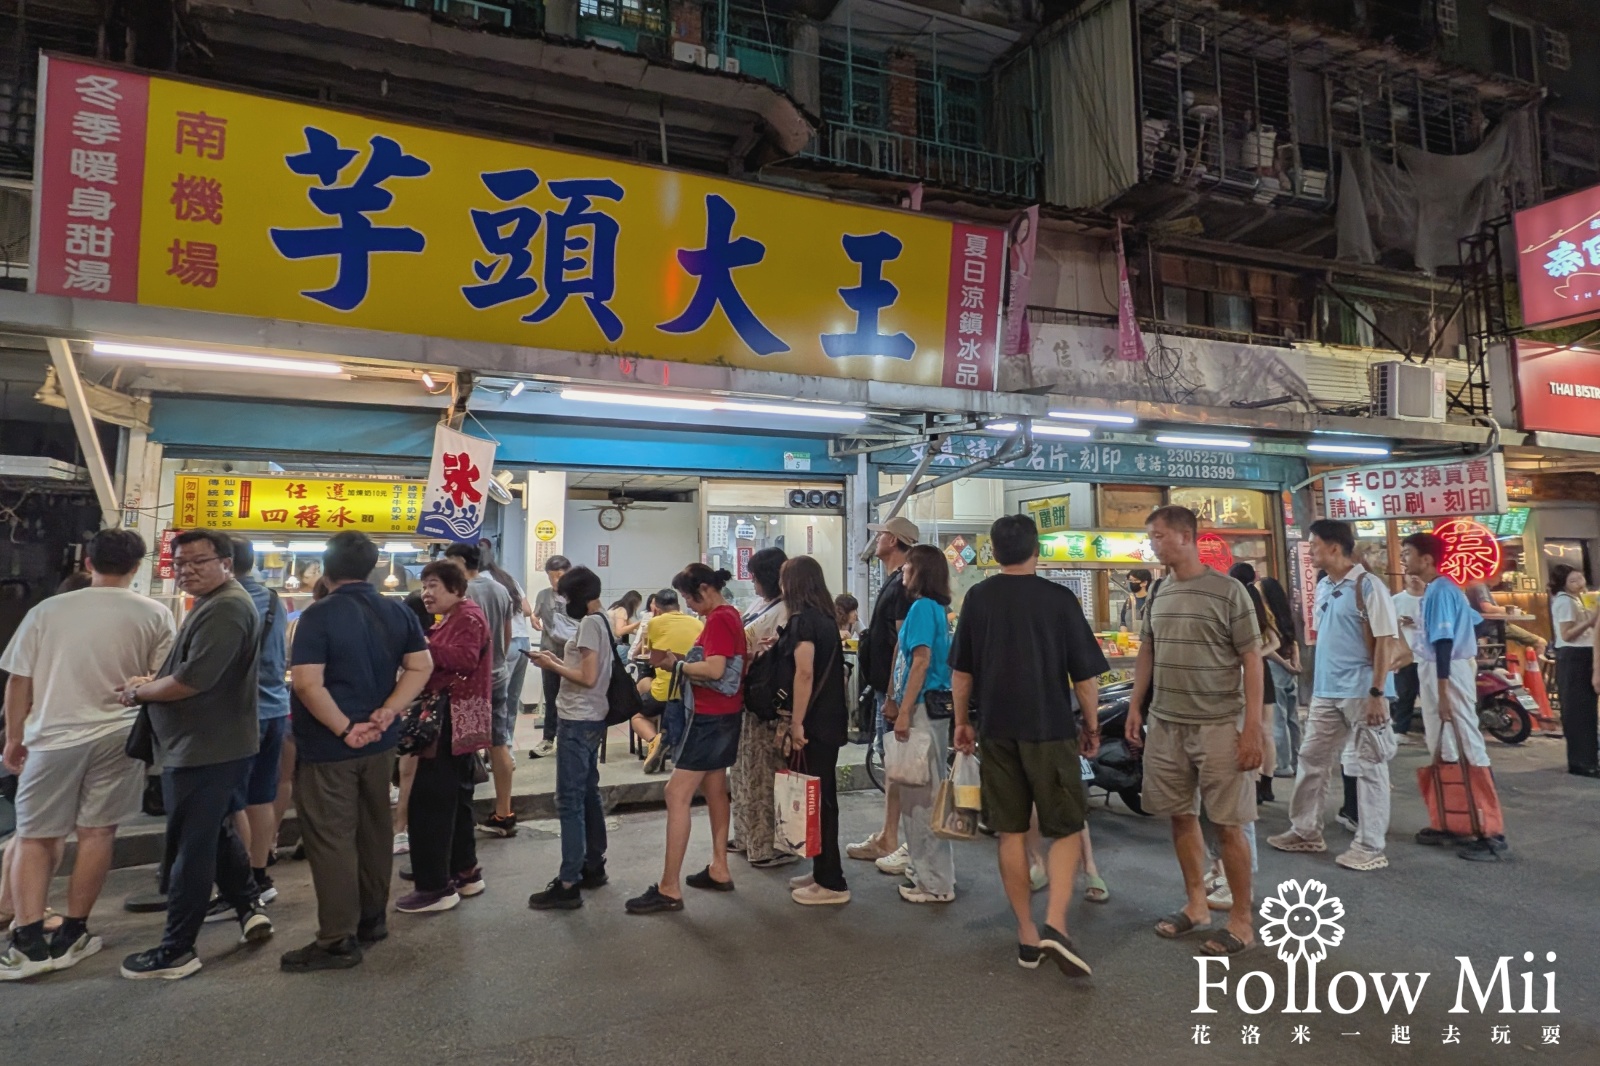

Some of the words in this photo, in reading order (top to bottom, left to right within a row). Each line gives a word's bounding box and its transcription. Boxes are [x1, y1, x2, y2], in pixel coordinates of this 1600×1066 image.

[63, 75, 123, 293] 冬季暖身甜湯
[166, 111, 228, 288] 南機場
[269, 126, 917, 361] 芋頭大王
[1549, 381, 1574, 397] THAI
[1167, 449, 1235, 465] 23052570
[1168, 464, 1235, 480] 23018399
[1328, 460, 1489, 493] 二手CD交換買賣
[260, 504, 356, 528] 四種冰
[361, 514, 374, 523] 80
